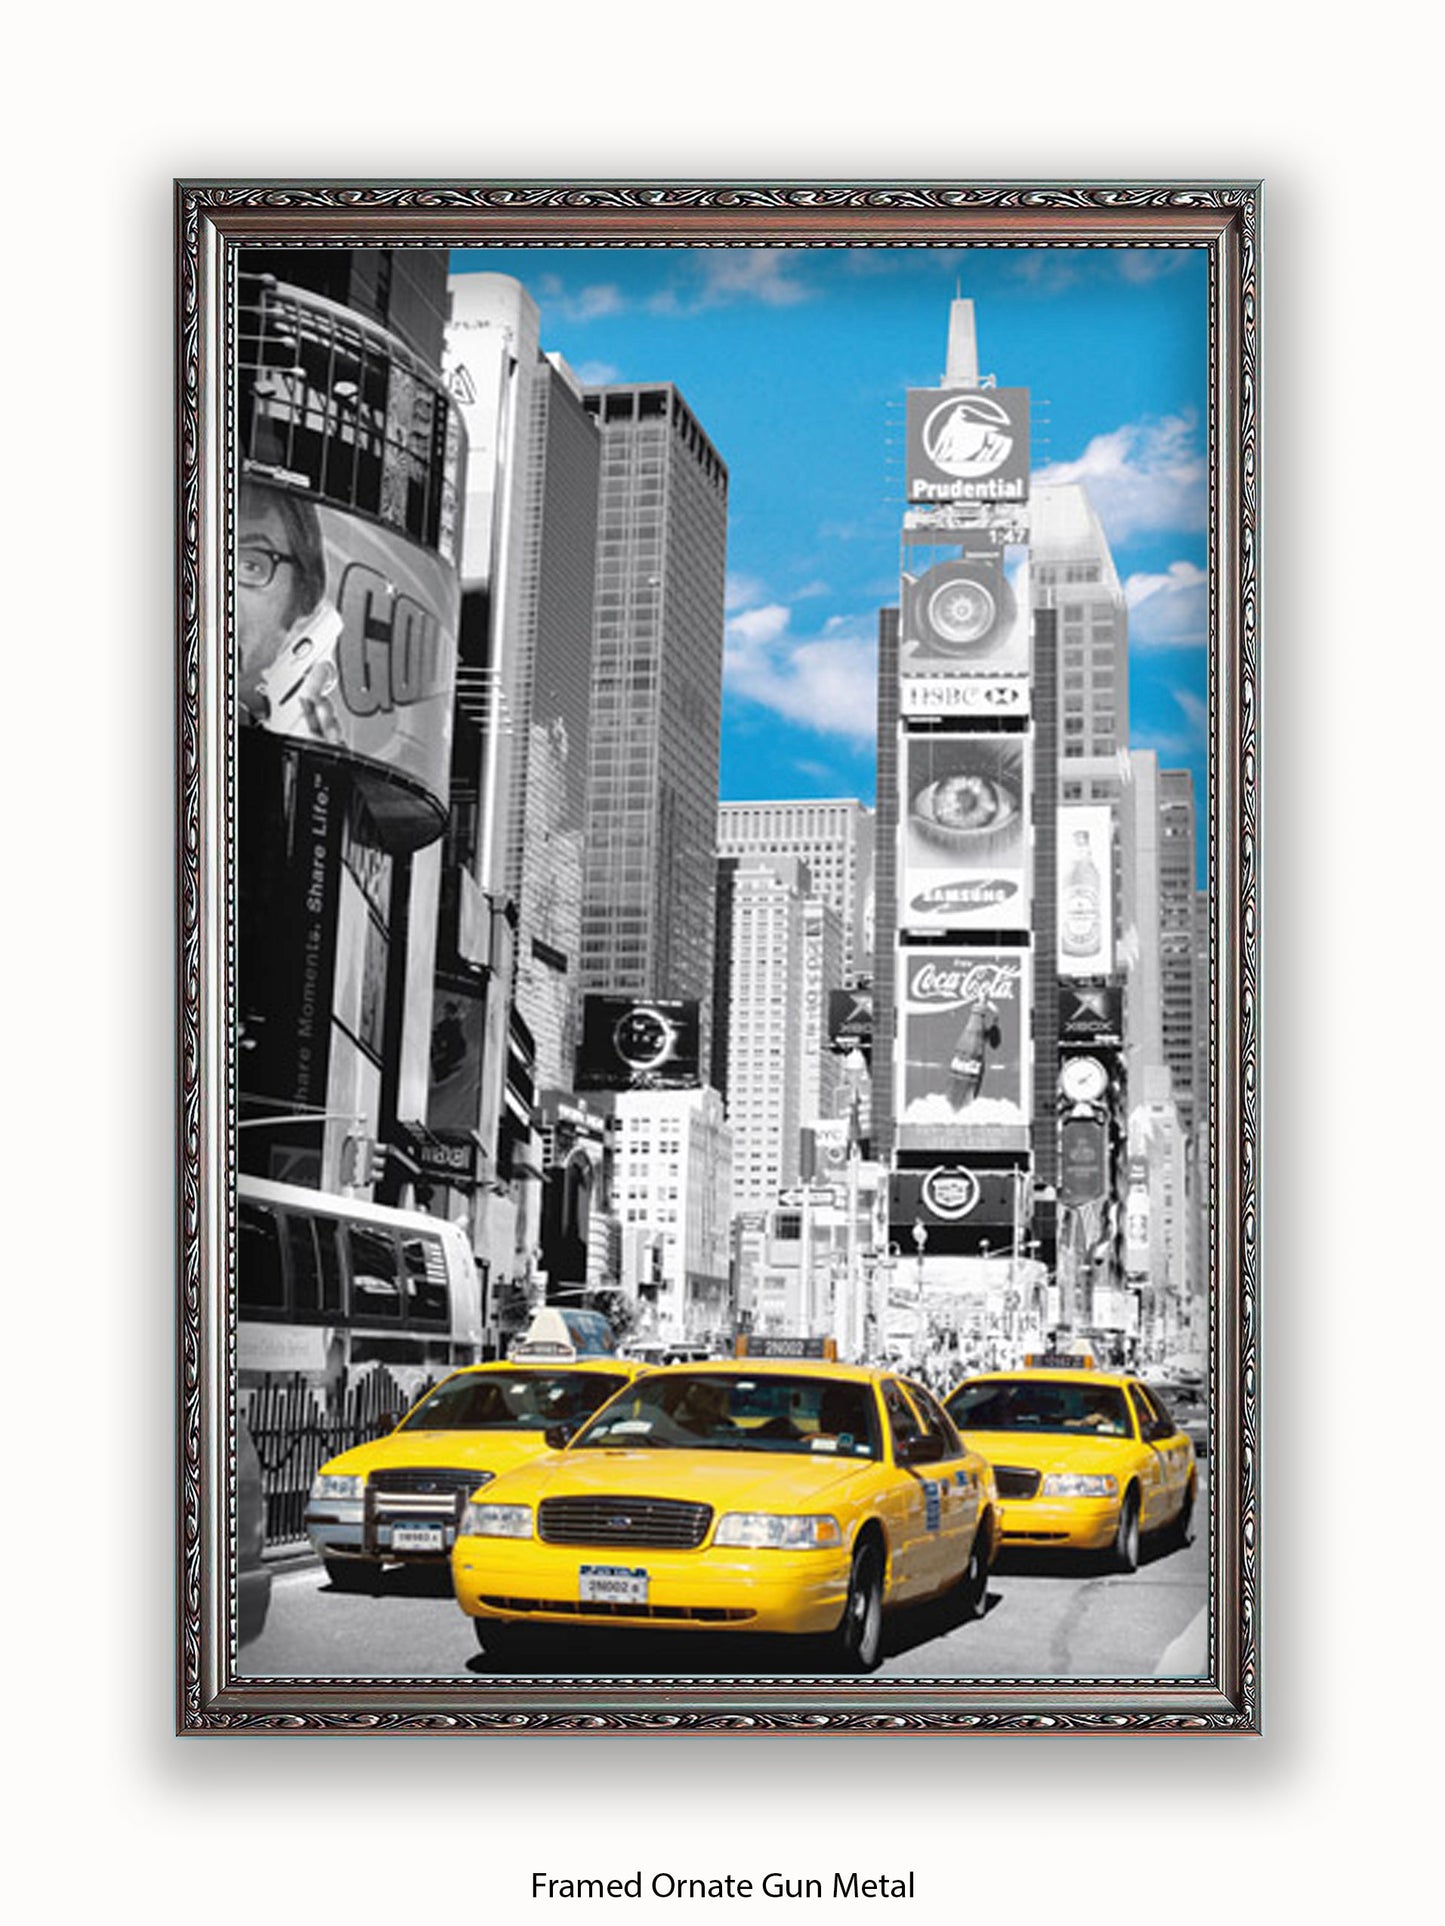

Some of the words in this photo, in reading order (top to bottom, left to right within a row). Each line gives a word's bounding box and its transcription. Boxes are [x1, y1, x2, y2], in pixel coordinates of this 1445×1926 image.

[913, 478, 1023, 499] Prudential
[909, 686, 979, 706] HSBC
[306, 844, 326, 913] Share
[922, 888, 1006, 903] SAMSUNG
[1065, 1020, 1113, 1032] XBOX
